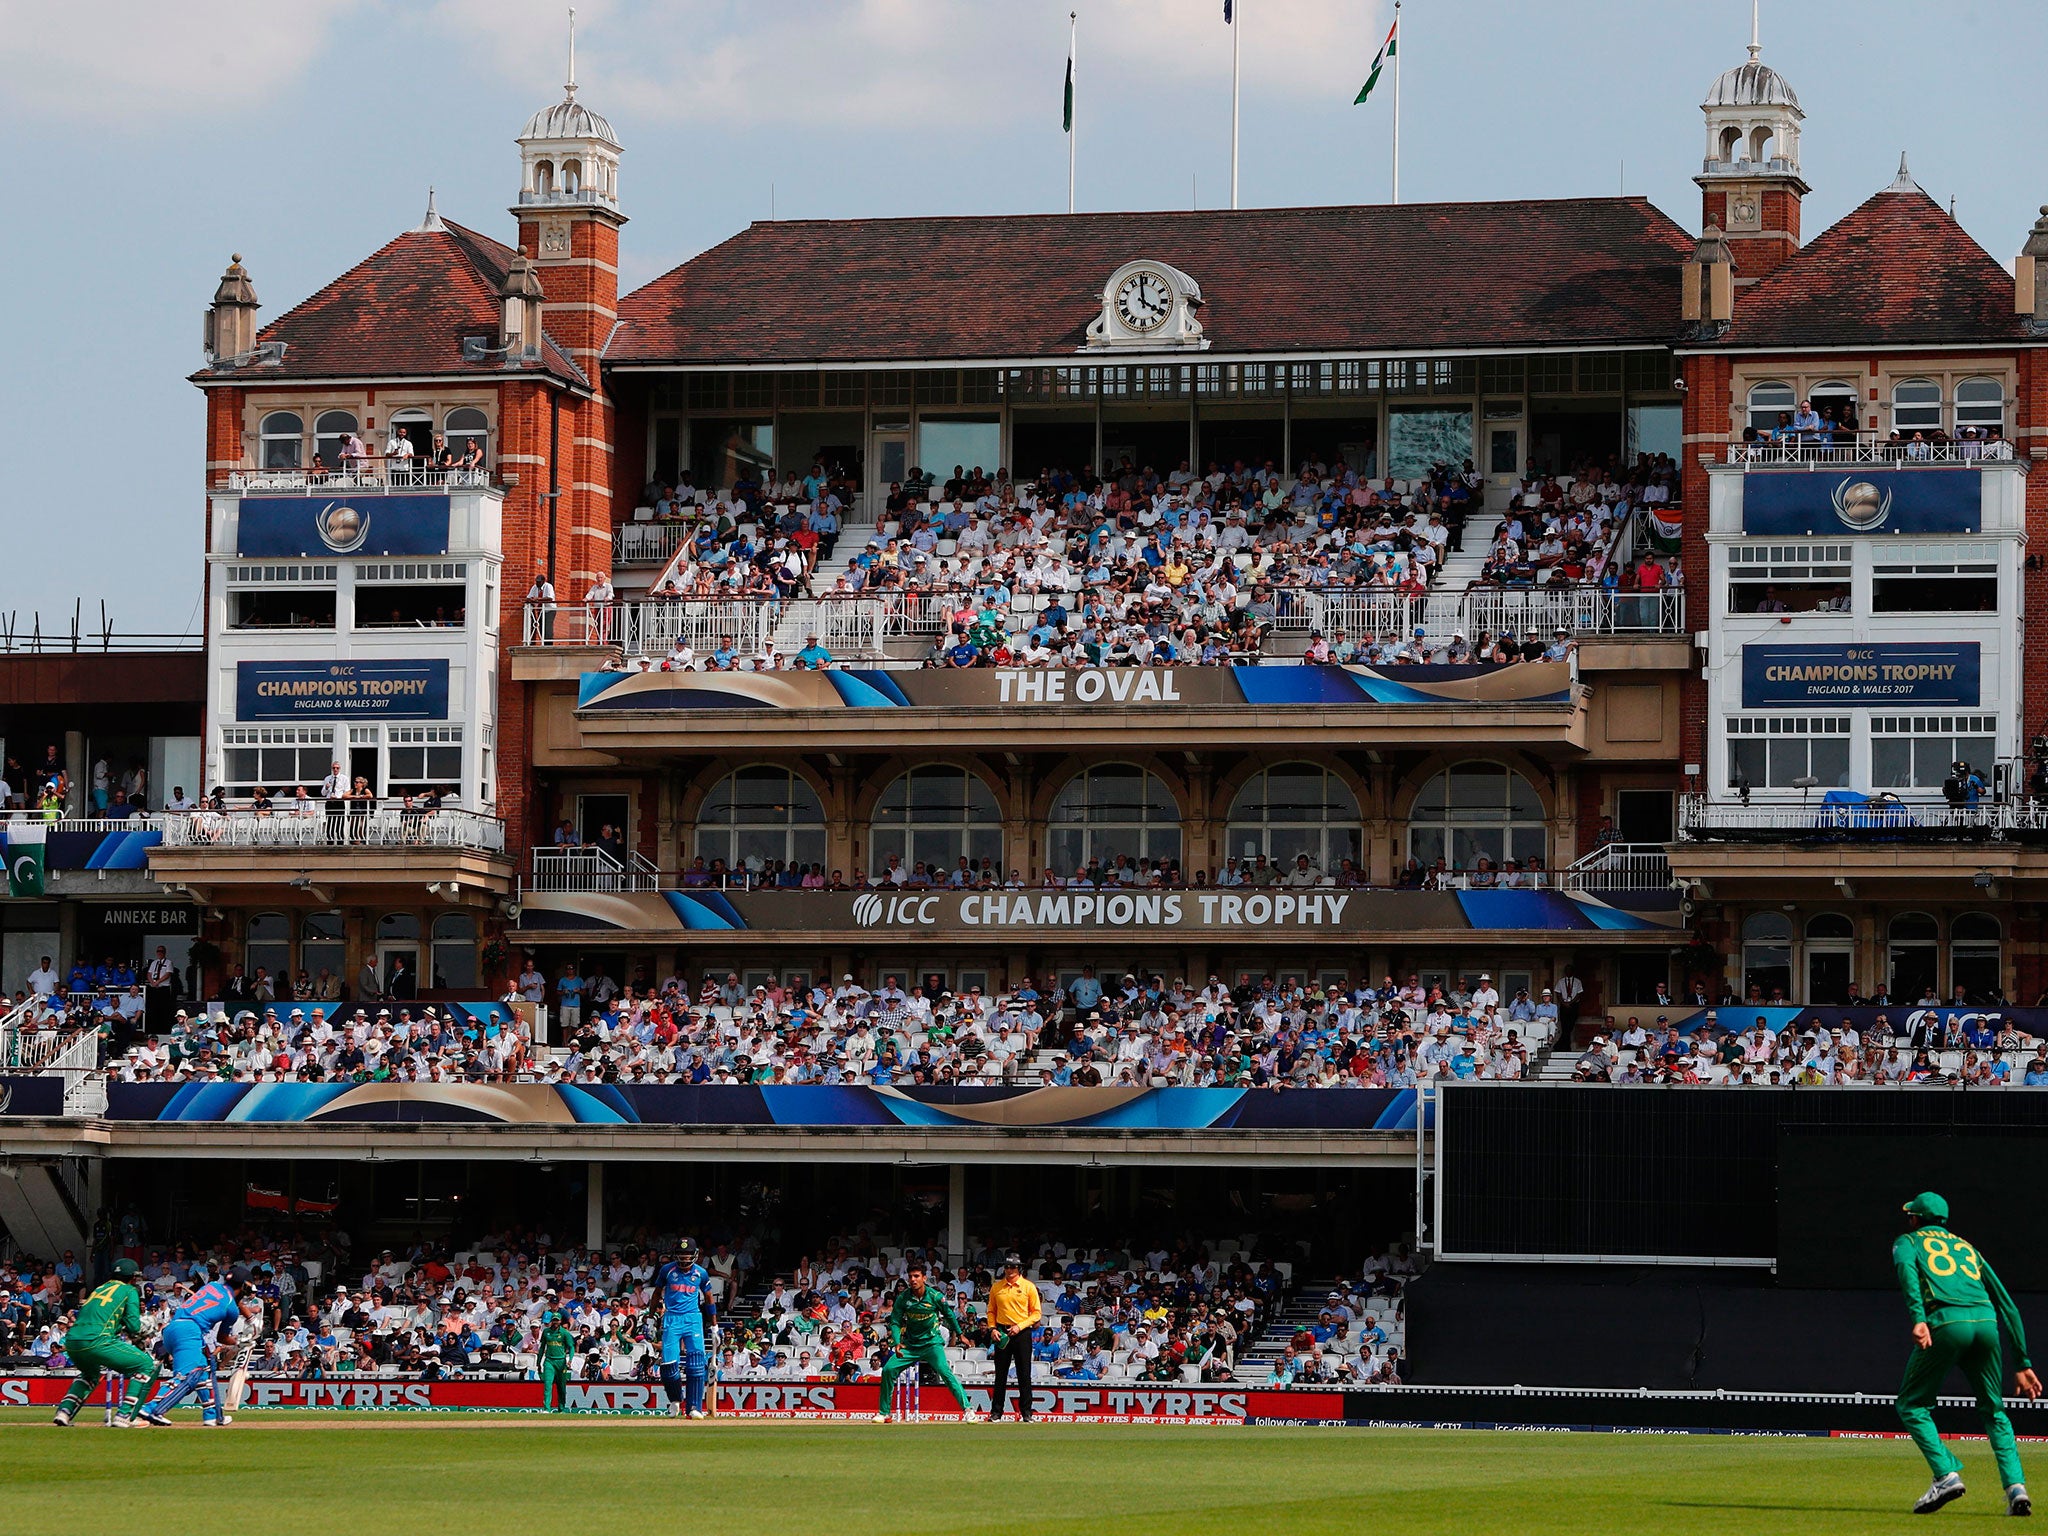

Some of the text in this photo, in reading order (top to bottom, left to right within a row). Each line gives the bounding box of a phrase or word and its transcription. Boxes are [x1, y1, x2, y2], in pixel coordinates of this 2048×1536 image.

[1858, 650, 1875, 660] ICC
[339, 667, 355, 676] ICC
[1765, 664, 1956, 682] CHAMPIONS TROPHY
[257, 680, 428, 697] CHAMPIONS TROPHY
[995, 670, 1180, 702] THE OVAL
[1807, 685, 1914, 695] ENGLAND & WALES 2017
[294, 699, 390, 709] ENGLAND & WALES 2017
[104, 910, 187, 924] ANNEXE BAR
[886, 895, 1350, 925] ICC CHAMPIONS TROPHY
[1923, 1238, 1979, 1281] 83
[299, 1383, 430, 1407] TYRES
[1107, 1391, 1247, 1417] TYRES
[1132, 1416, 1158, 1424] MRF
[1188, 1417, 1215, 1425] MRF
